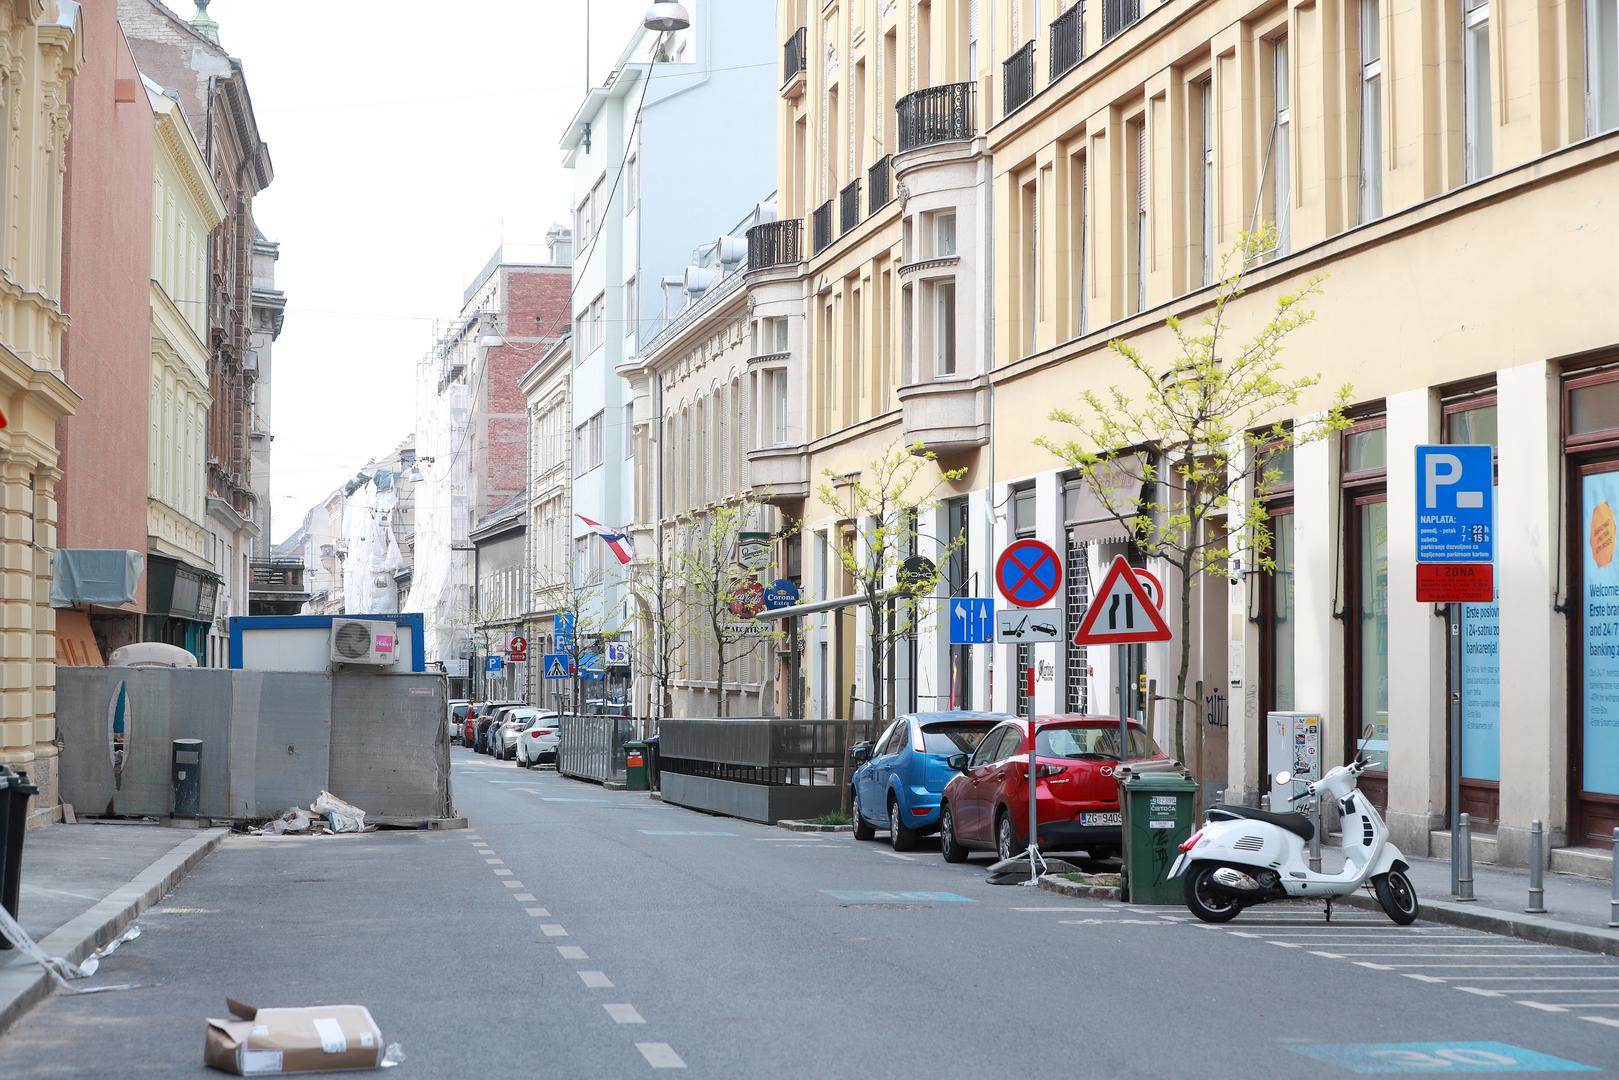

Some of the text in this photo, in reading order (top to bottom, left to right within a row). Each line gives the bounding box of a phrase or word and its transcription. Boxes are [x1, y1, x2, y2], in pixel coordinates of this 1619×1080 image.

[1425, 453, 1463, 509] P
[1420, 515, 1457, 524] NAPLATA:
[1461, 525, 1467, 533] 7
[1472, 525, 1483, 534] 22
[1484, 525, 1489, 533] h
[1461, 534, 1467, 542] 7
[1473, 534, 1483, 543] 15
[1484, 534, 1489, 542] h
[1445, 567, 1475, 577] ZONA
[1466, 606, 1479, 618] Erste
[1590, 603, 1605, 617] Erste
[1590, 622, 1602, 636] and
[1590, 641, 1615, 659] banking
[489, 658, 496, 669] P
[1087, 813, 1098, 824] ZG
